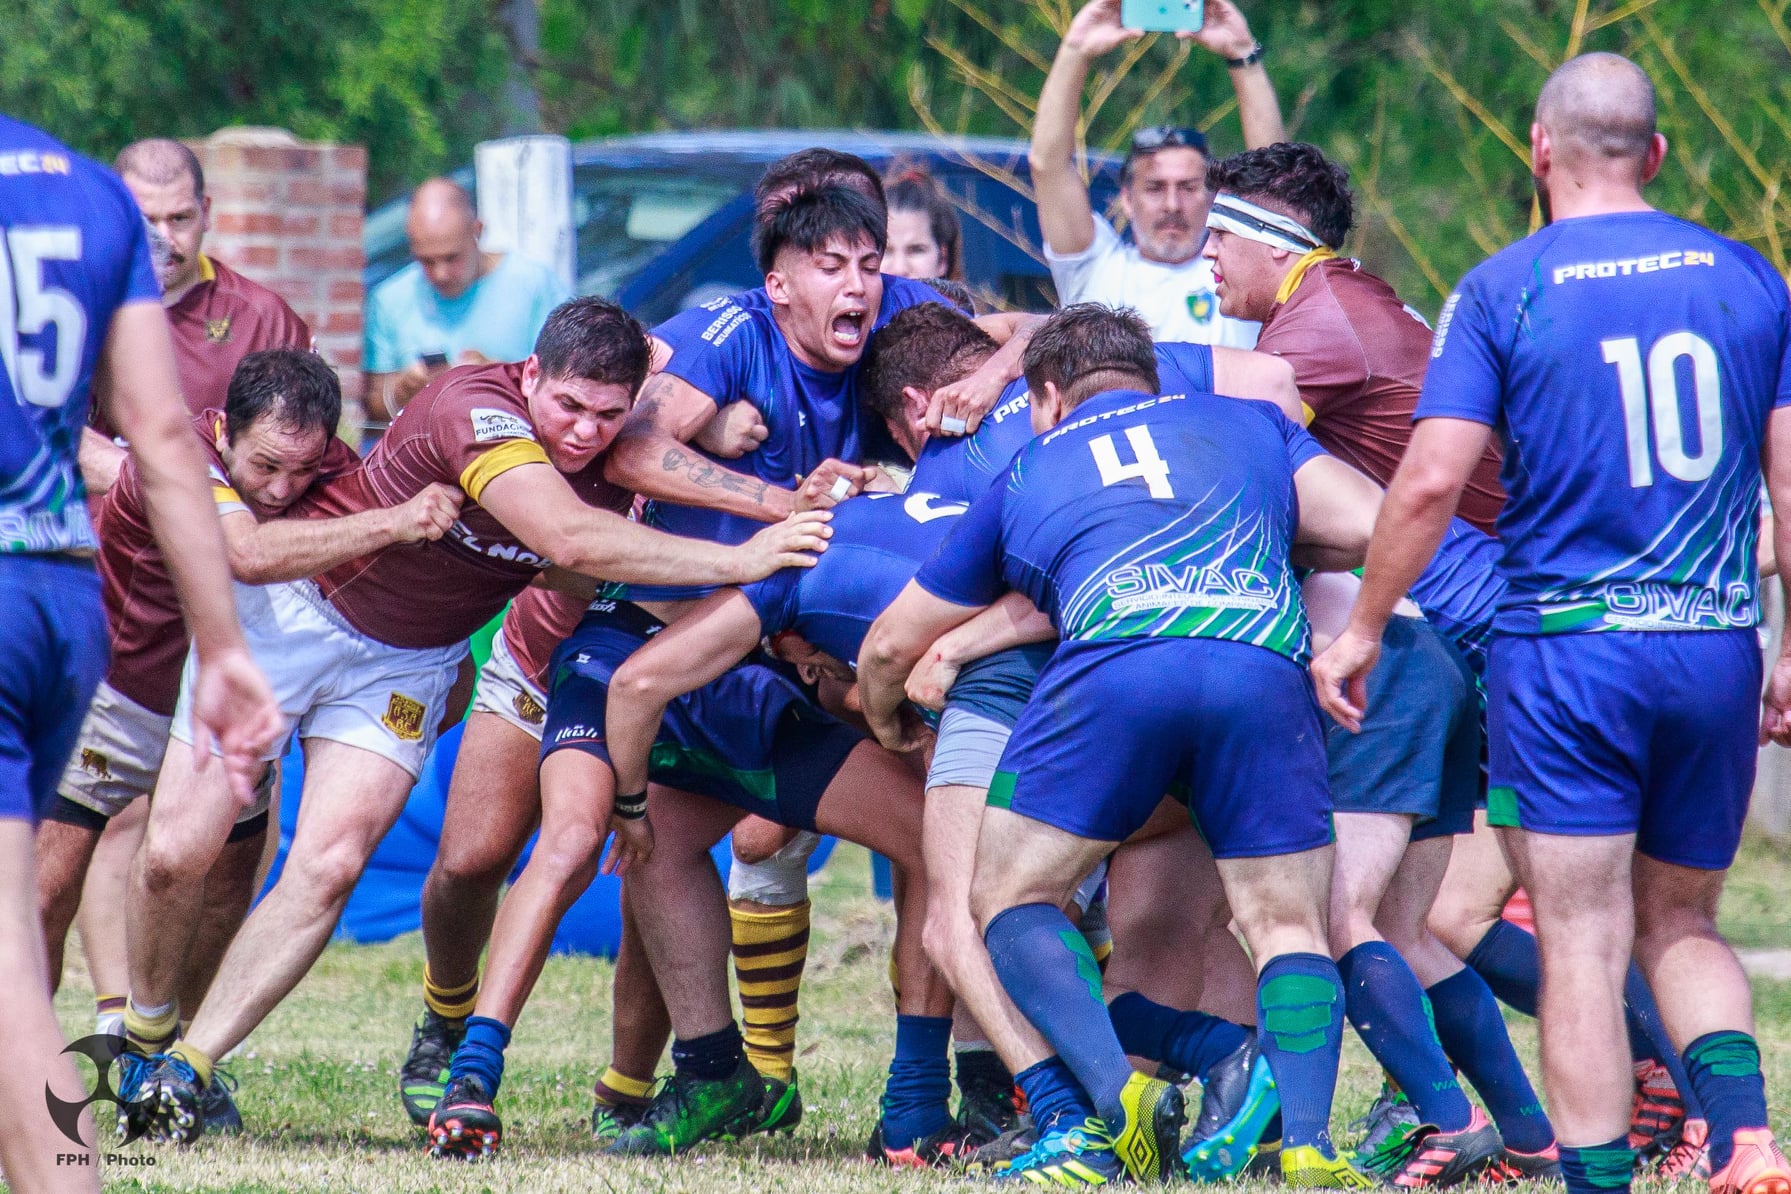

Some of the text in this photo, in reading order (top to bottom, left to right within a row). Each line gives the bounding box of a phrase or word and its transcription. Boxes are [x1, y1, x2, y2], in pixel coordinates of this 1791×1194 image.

[1600, 332, 1724, 488] 10
[1088, 424, 1175, 499] 4
[1105, 563, 1274, 599] SIVAC
[1605, 582, 1757, 627] SIVAC
